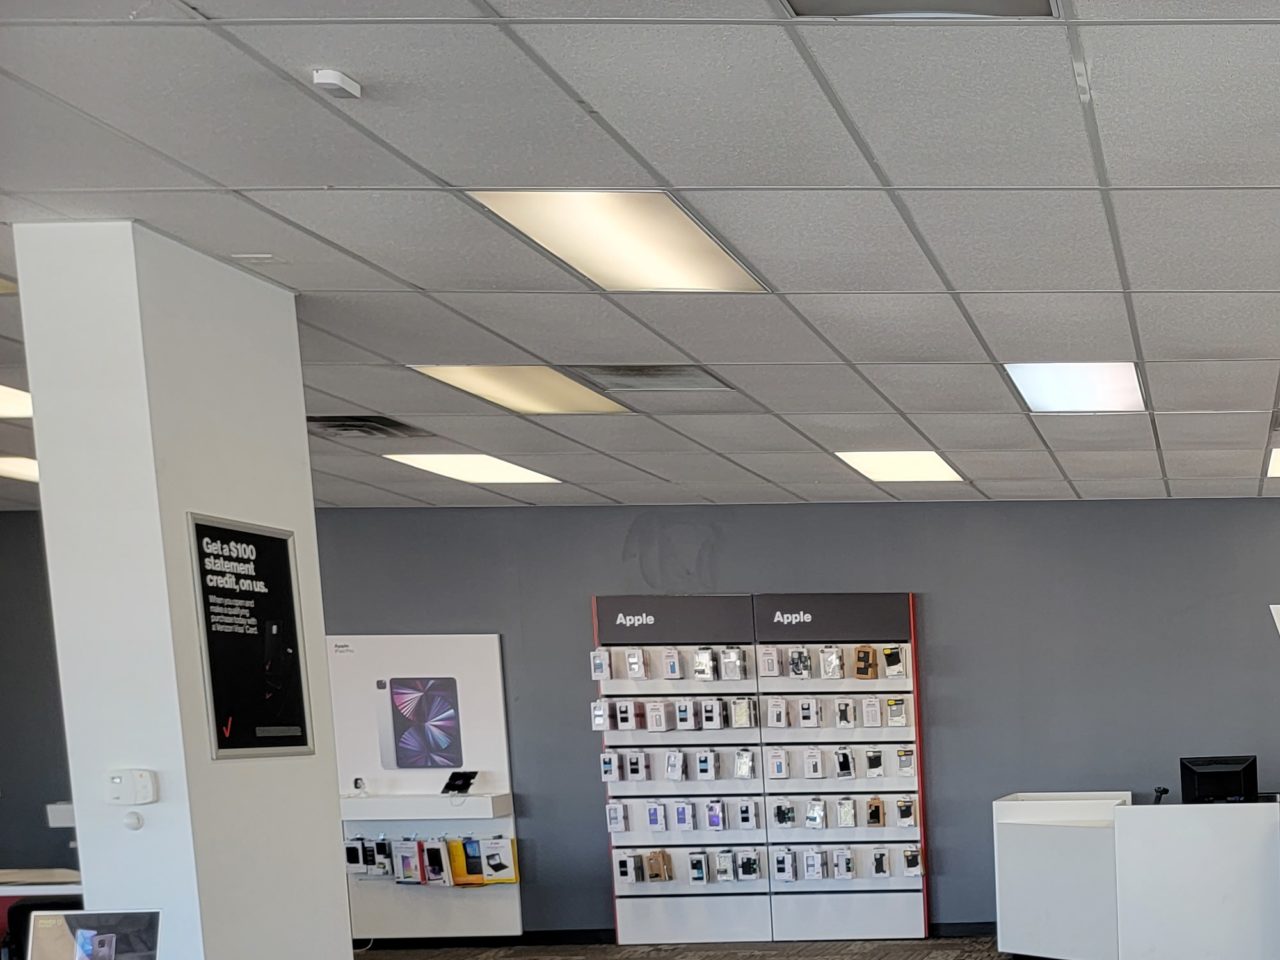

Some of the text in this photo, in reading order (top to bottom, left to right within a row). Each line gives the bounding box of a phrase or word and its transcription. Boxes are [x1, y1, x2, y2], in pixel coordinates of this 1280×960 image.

[202, 537, 256, 560] Get a $100
[204, 556, 256, 576] statement
[206, 573, 268, 593] credit, on us.
[616, 613, 655, 626] Apple
[773, 611, 812, 625] Apple
